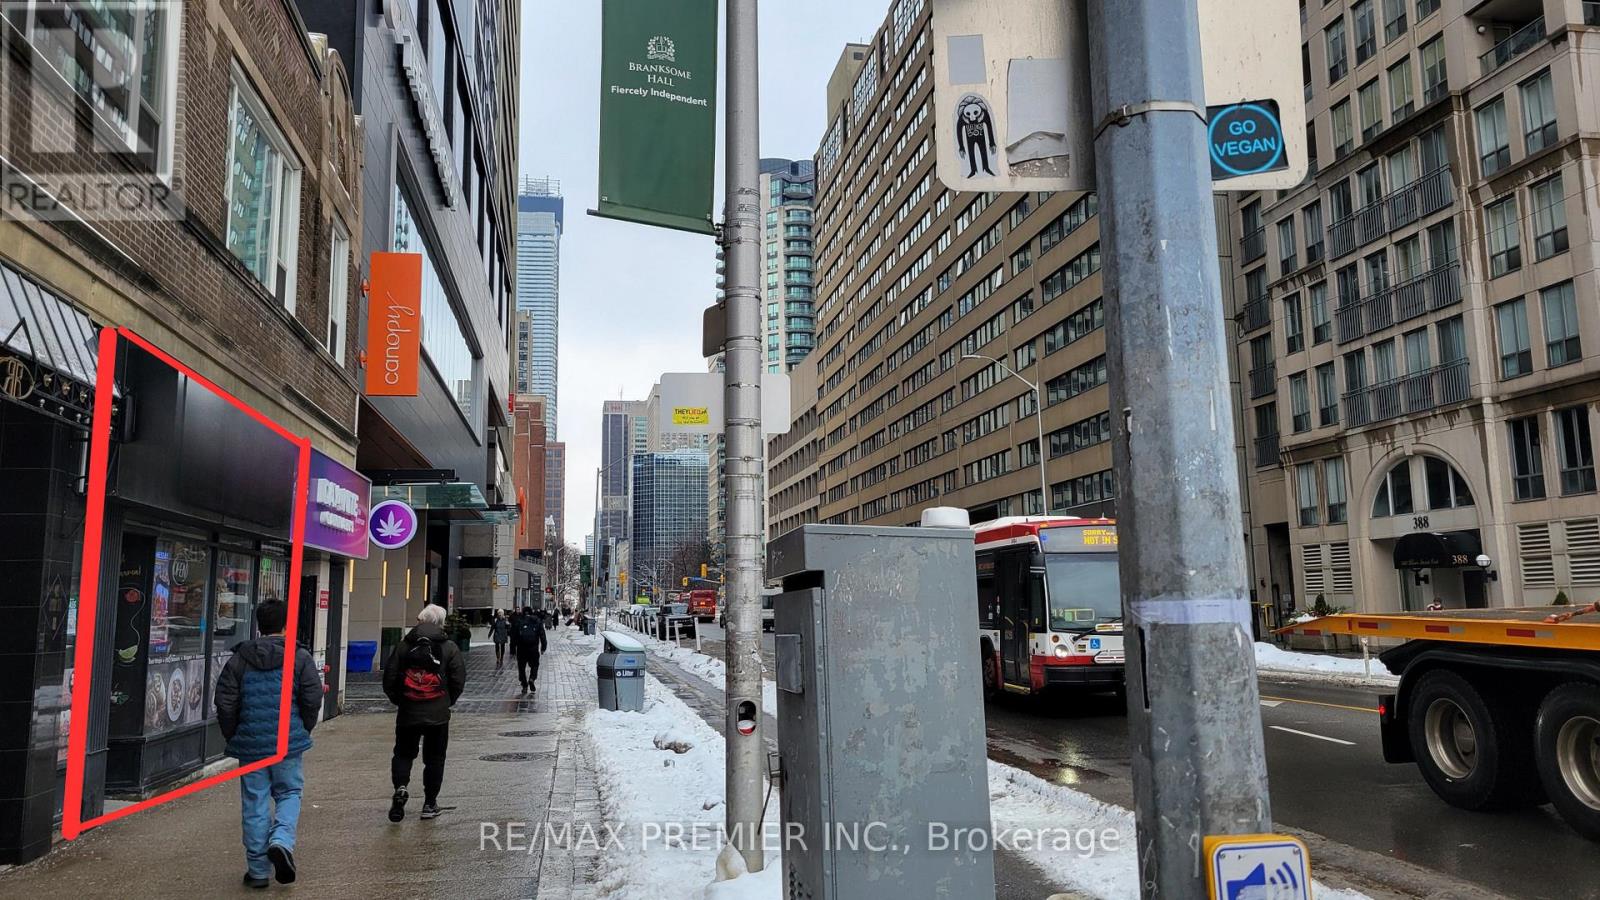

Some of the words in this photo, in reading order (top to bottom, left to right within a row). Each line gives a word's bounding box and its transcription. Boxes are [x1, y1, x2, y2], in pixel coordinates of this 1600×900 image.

[629, 62, 692, 79] BRANKSOME
[647, 74, 675, 87] HALL
[611, 85, 648, 97] Fiercely
[650, 87, 708, 107] Independent
[1228, 118, 1256, 136] GO
[1214, 136, 1276, 158] VEGAN
[384, 291, 416, 385] canopy
[1412, 516, 1429, 530] 388
[1083, 536, 1098, 545] NOT
[1451, 554, 1468, 565] 388
